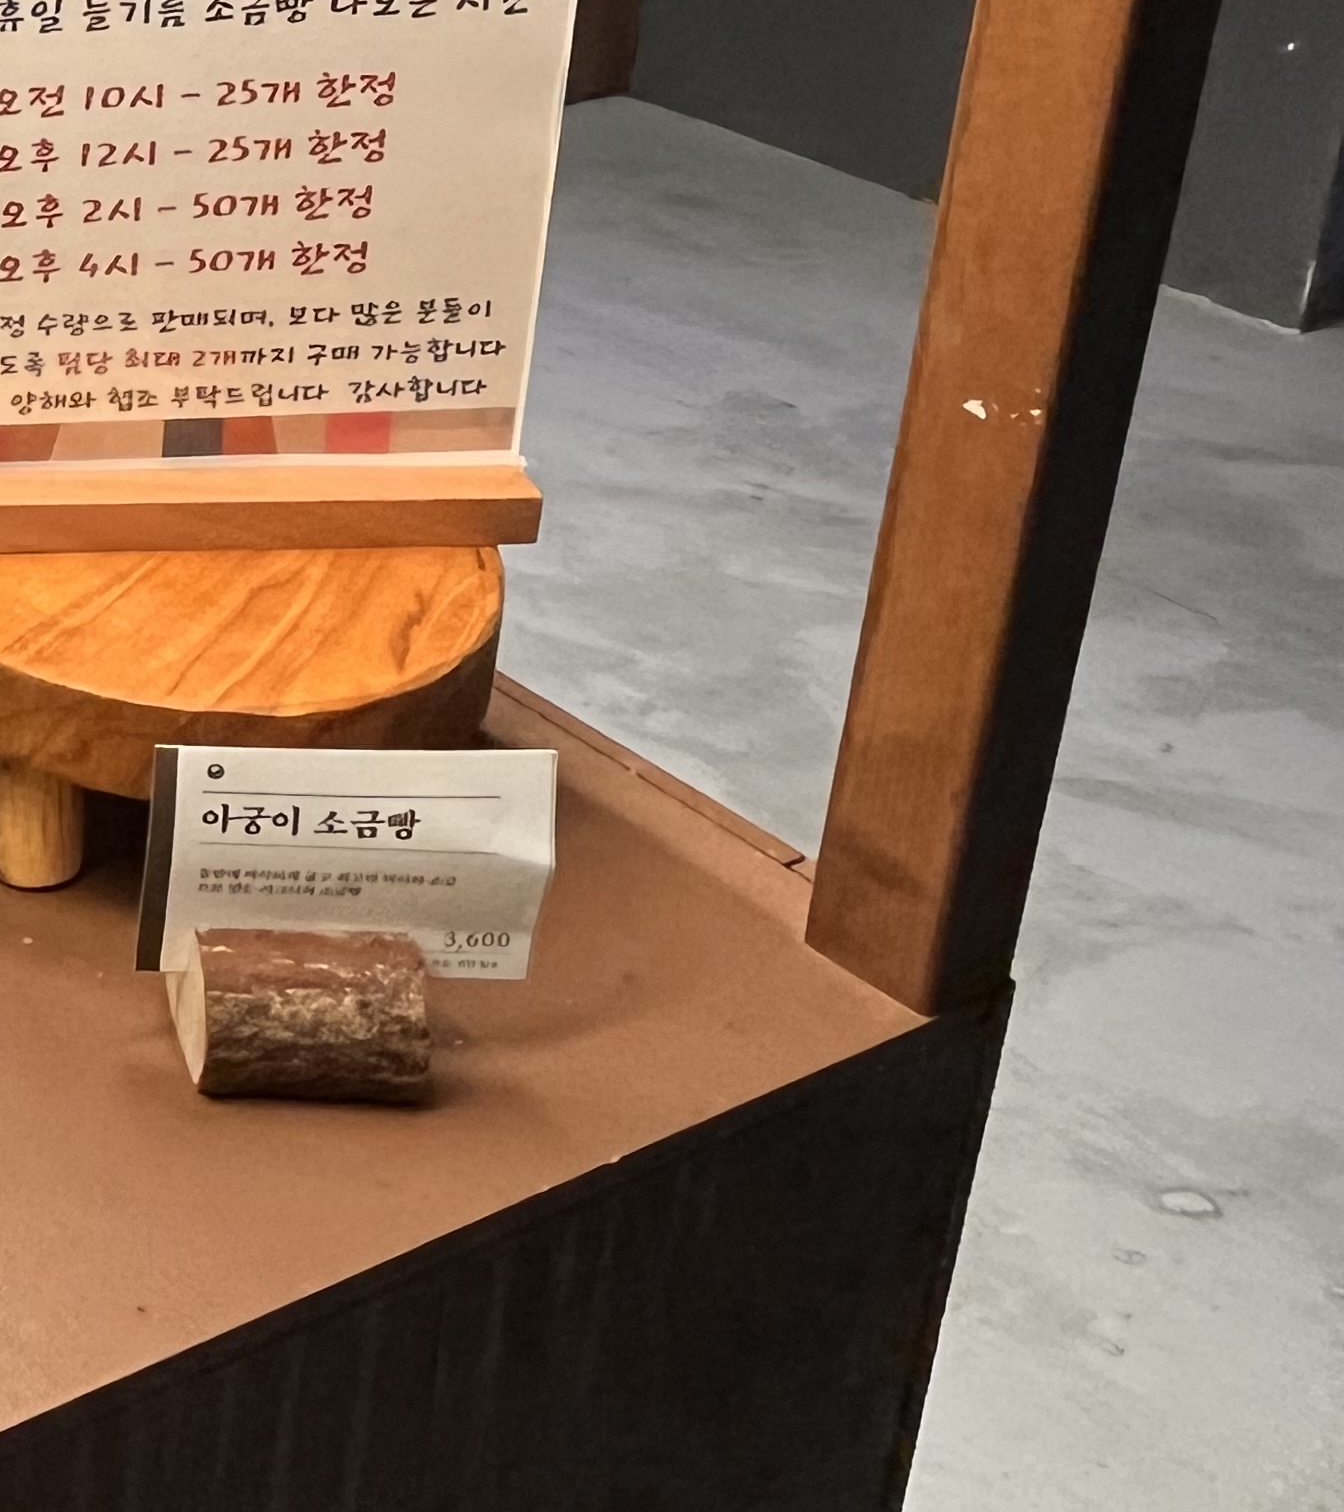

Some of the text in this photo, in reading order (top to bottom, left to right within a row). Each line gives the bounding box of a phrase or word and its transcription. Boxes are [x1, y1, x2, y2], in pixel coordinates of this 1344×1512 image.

[84, 83, 164, 111] 10시
[215, 79, 301, 107] 25개
[315, 71, 397, 108] 한정
[80, 140, 157, 168] 12시
[207, 137, 292, 164] 25개
[307, 128, 388, 165] 한정
[0, 193, 64, 228] 오후
[81, 196, 143, 224] 2시
[191, 192, 280, 220] 50개
[294, 184, 375, 221] 한정
[78, 252, 139, 278] 4시
[188, 248, 276, 274] 50개
[290, 240, 370, 276] 한정
[36, 310, 139, 336] 수량으로
[288, 305, 341, 326] 보다
[350, 299, 403, 327] 많은
[416, 297, 492, 325] 분들이
[124, 347, 181, 369] 최대
[191, 345, 294, 368] 2개까지
[306, 342, 359, 366] 구매
[369, 337, 507, 365] 가능합니다
[10, 390, 98, 416] 양해와
[108, 386, 160, 412] 협조
[170, 384, 330, 410] 부탁드립니다
[347, 375, 488, 404] 감사합니다
[201, 803, 422, 840] 아궁이 소금빵
[443, 930, 511, 953] 3,600
